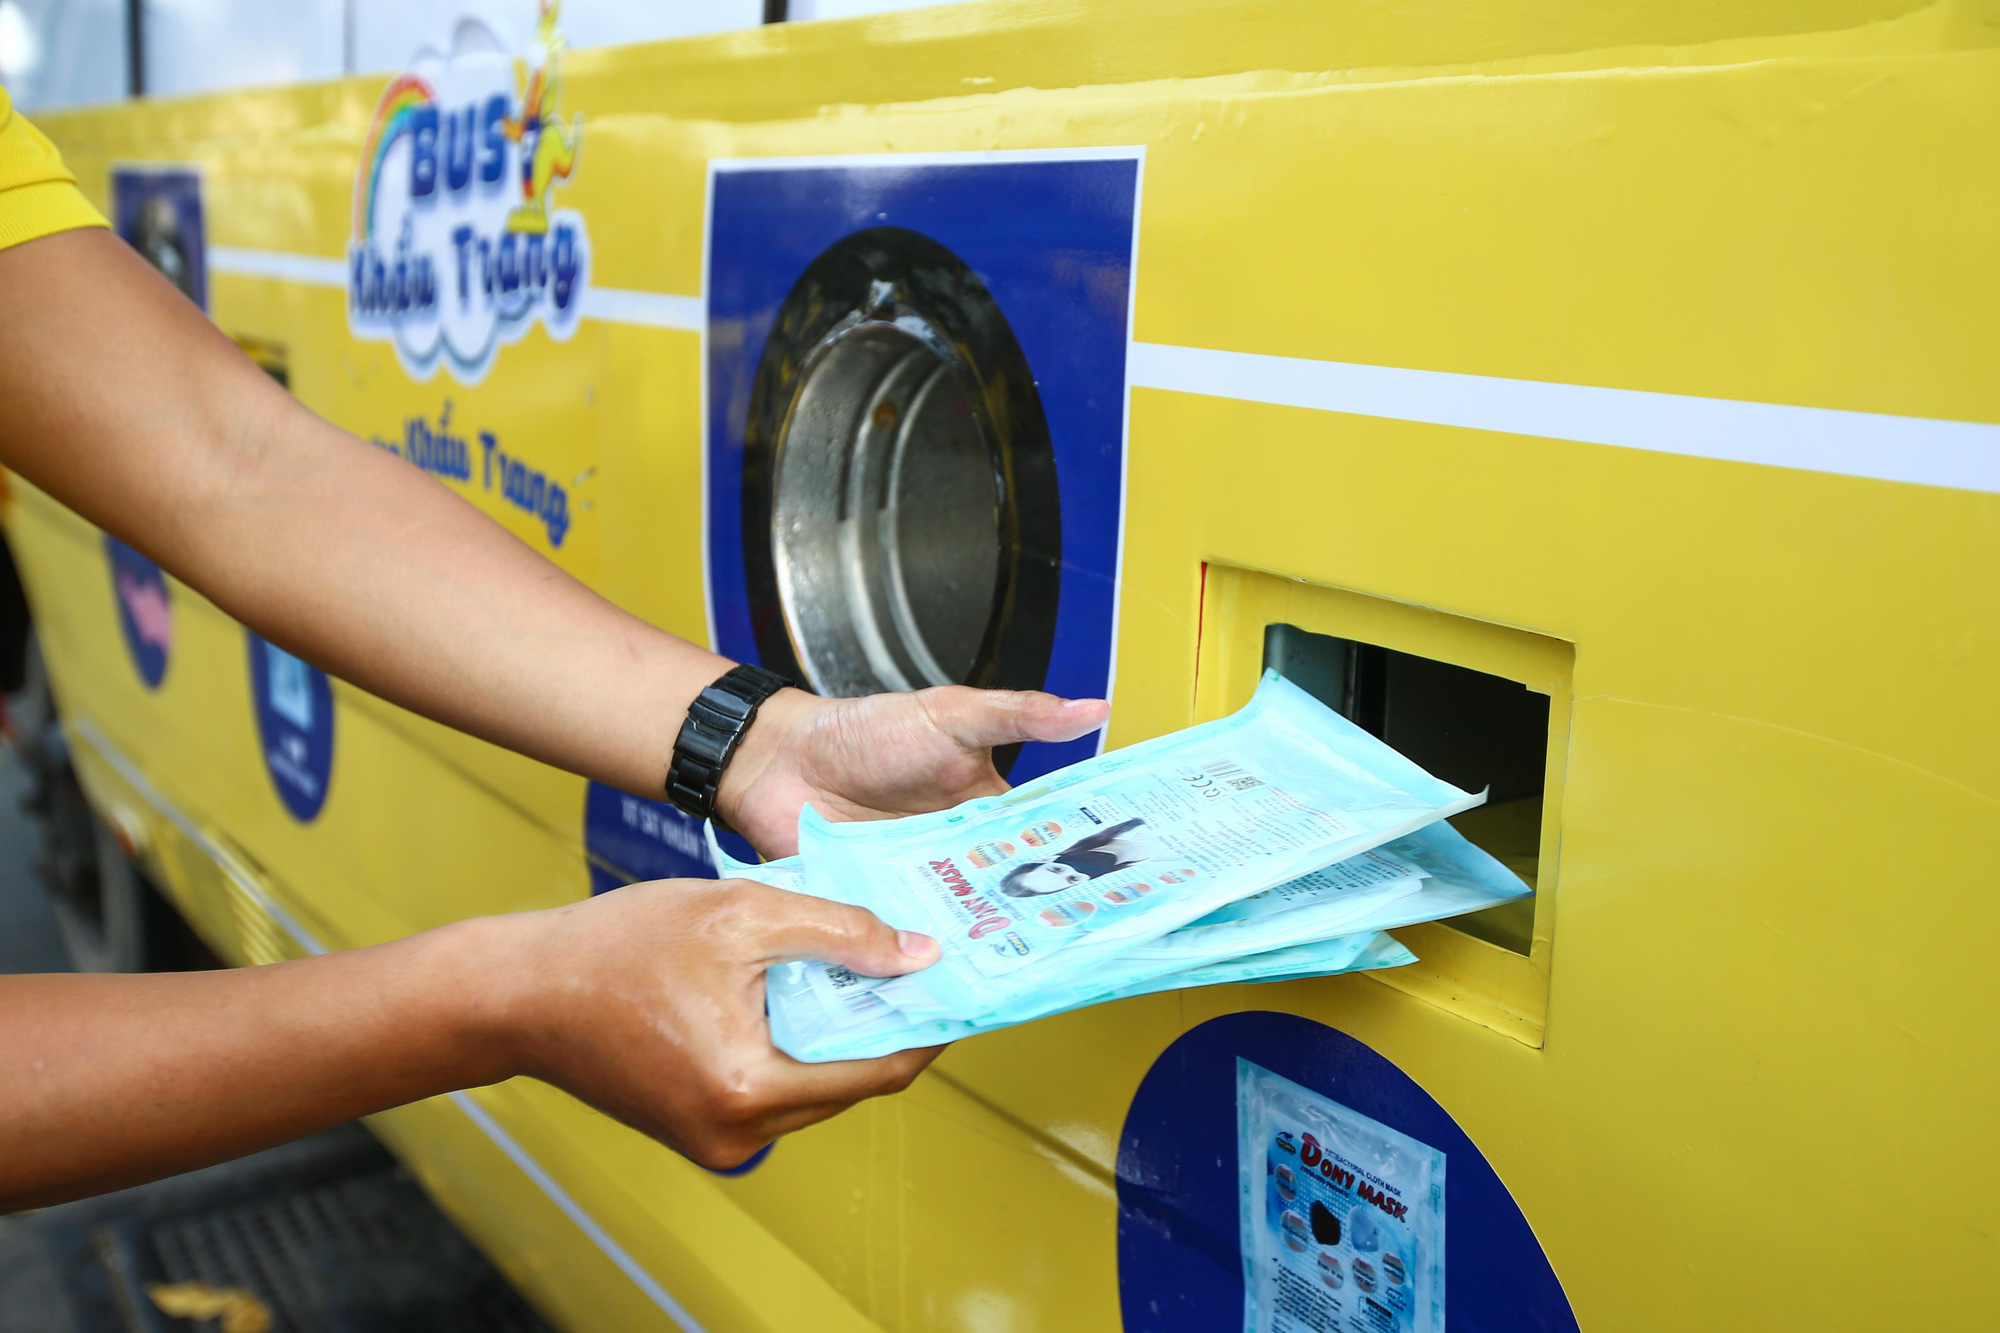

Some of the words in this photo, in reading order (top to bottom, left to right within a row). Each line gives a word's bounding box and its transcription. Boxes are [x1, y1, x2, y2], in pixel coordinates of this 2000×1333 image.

[411, 92, 508, 197] BUS
[452, 223, 577, 310] Trang
[479, 430, 571, 548] Trang
[928, 857, 973, 896] MASK
[961, 895, 1011, 939] DONY
[1300, 1132, 1355, 1189] DONY
[1357, 1181, 1409, 1223] MASK
[1366, 1172, 1385, 1188] CLOTH
[1385, 1181, 1403, 1198] MASK
